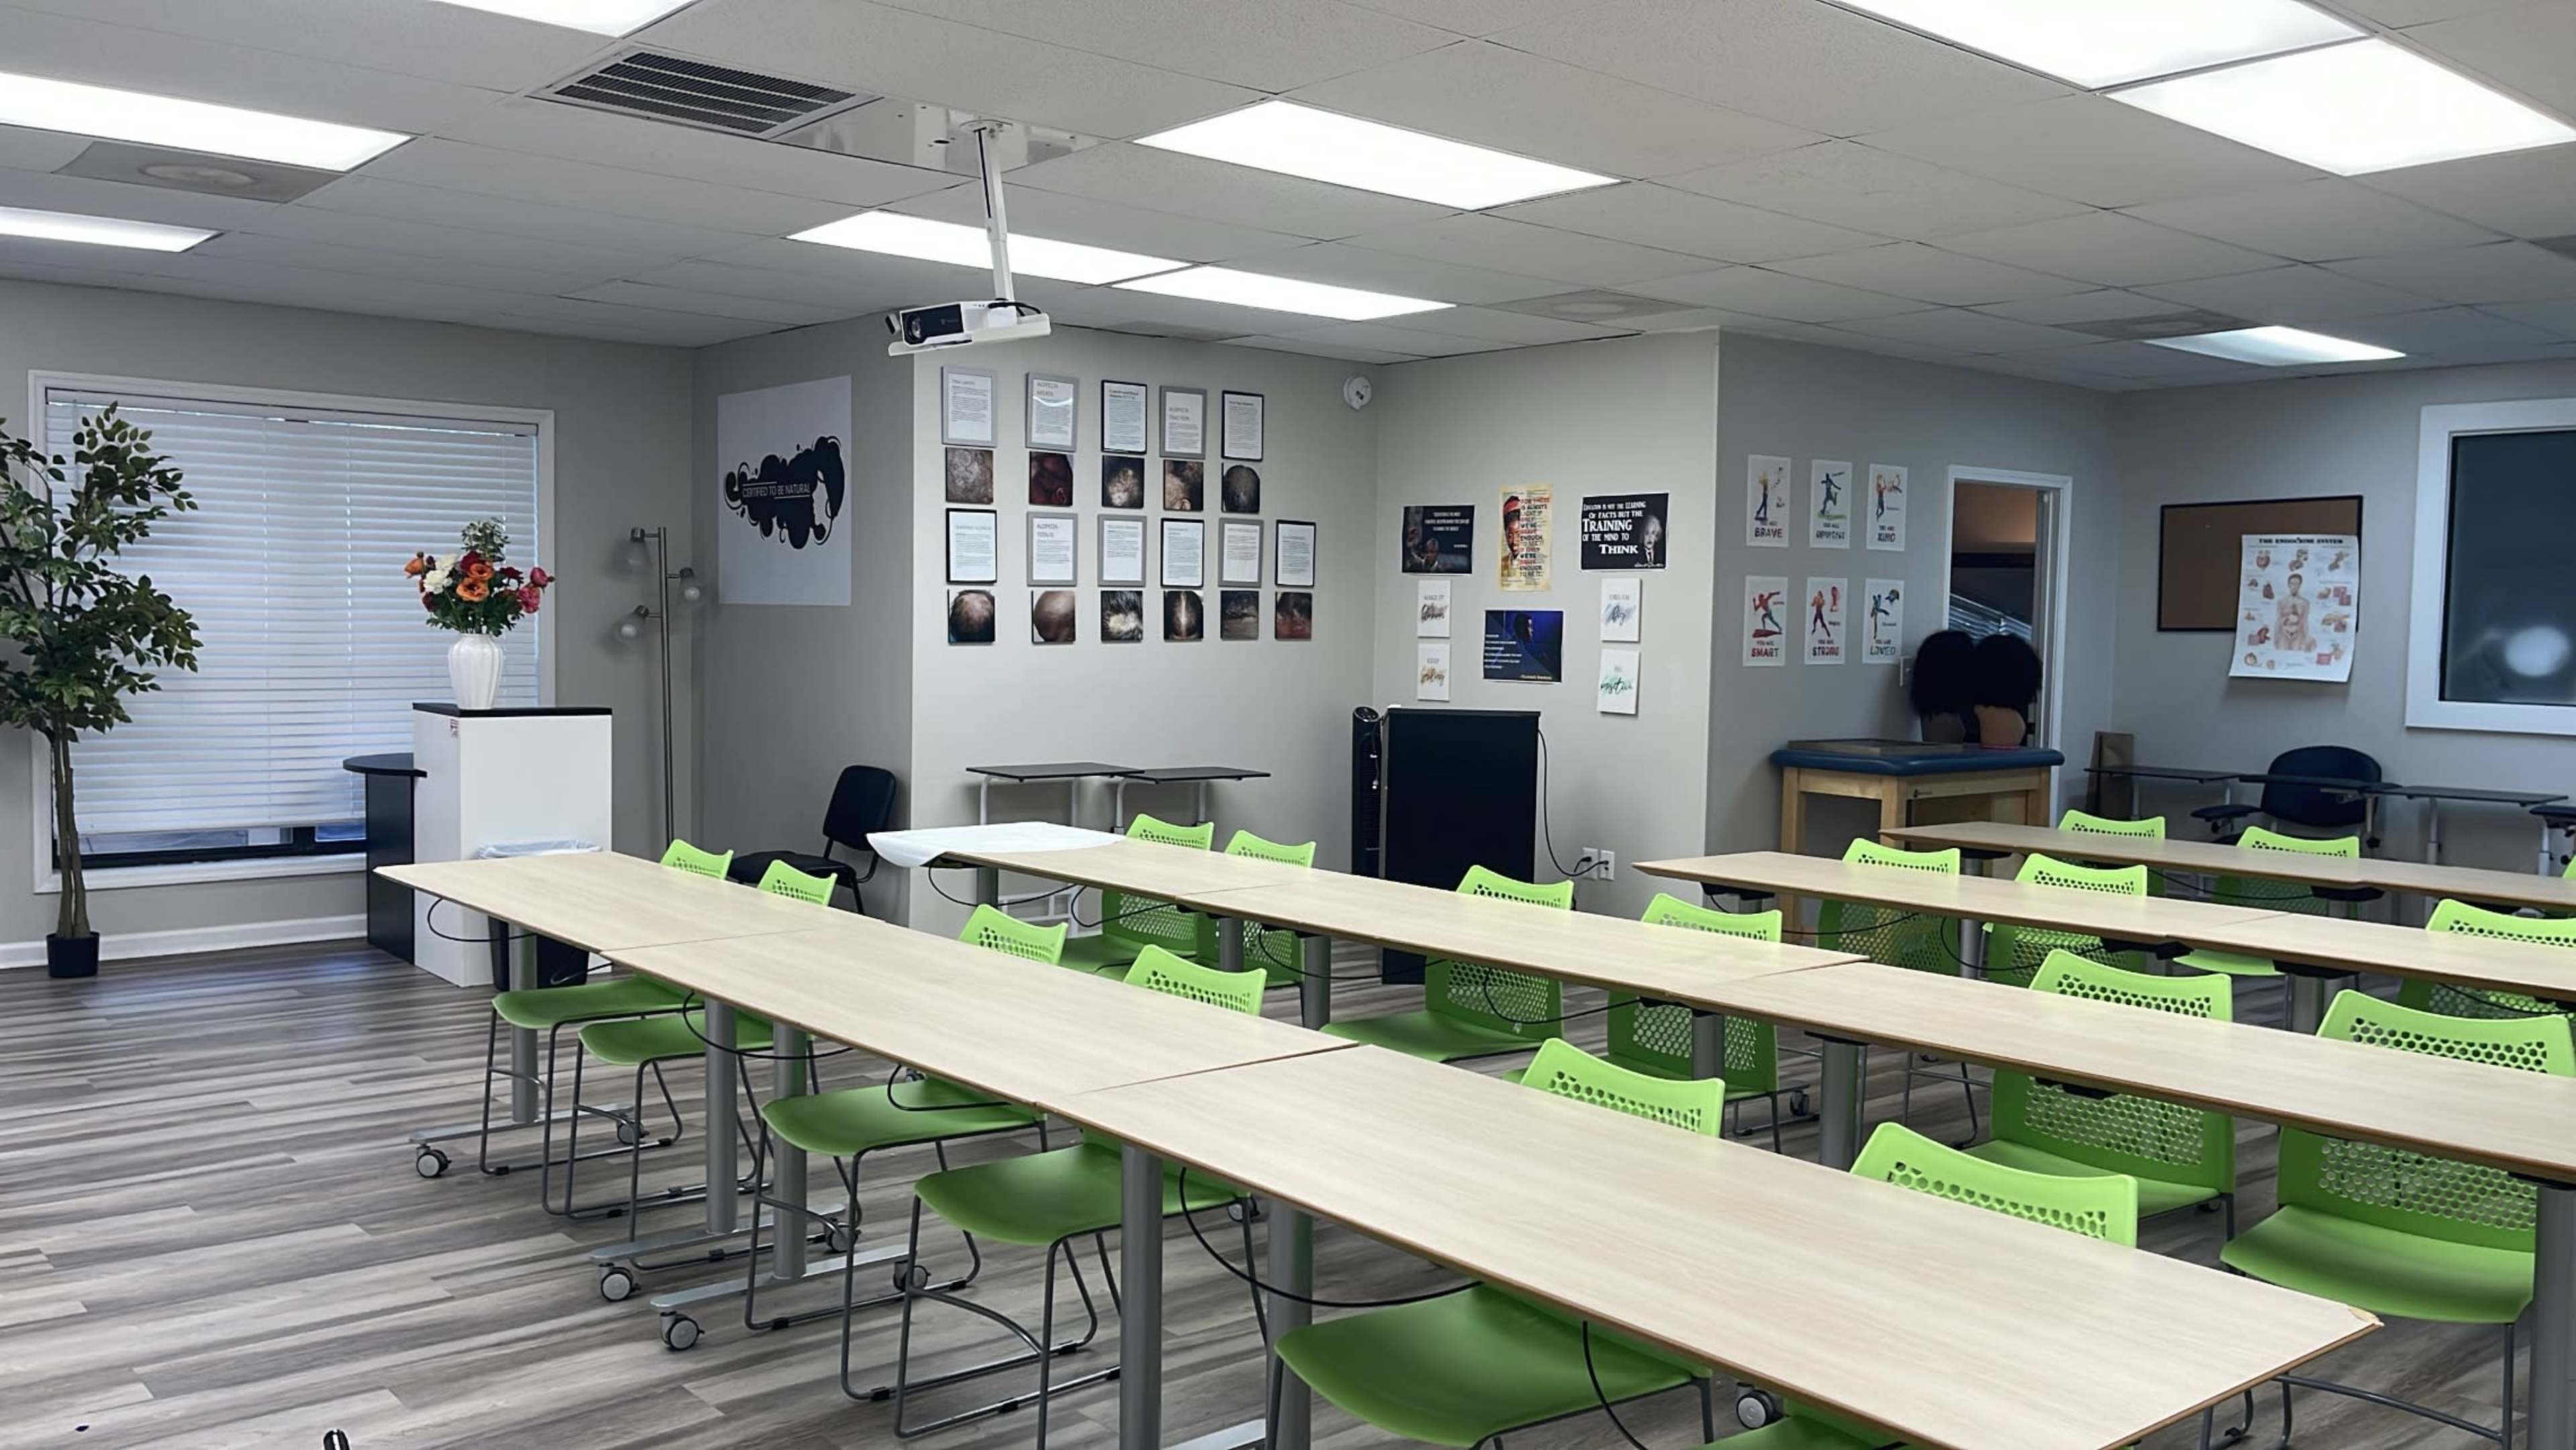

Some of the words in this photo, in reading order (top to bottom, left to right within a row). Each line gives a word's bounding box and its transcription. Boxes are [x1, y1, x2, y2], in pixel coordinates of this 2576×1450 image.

[742, 486, 768, 497] CERTIFIED
[769, 485, 777, 496] TO
[778, 485, 784, 495] BE
[785, 483, 810, 495] NATURAL
[1582, 533, 1589, 541] OF
[1591, 533, 1602, 541] THE
[1604, 533, 1619, 541] MIND
[1621, 533, 1629, 541] TO
[1754, 527, 1783, 538] BRAVE
[1751, 647, 1779, 658] SMART
[1813, 646, 1839, 657] STRONG
[1870, 646, 1896, 656] LOVED
